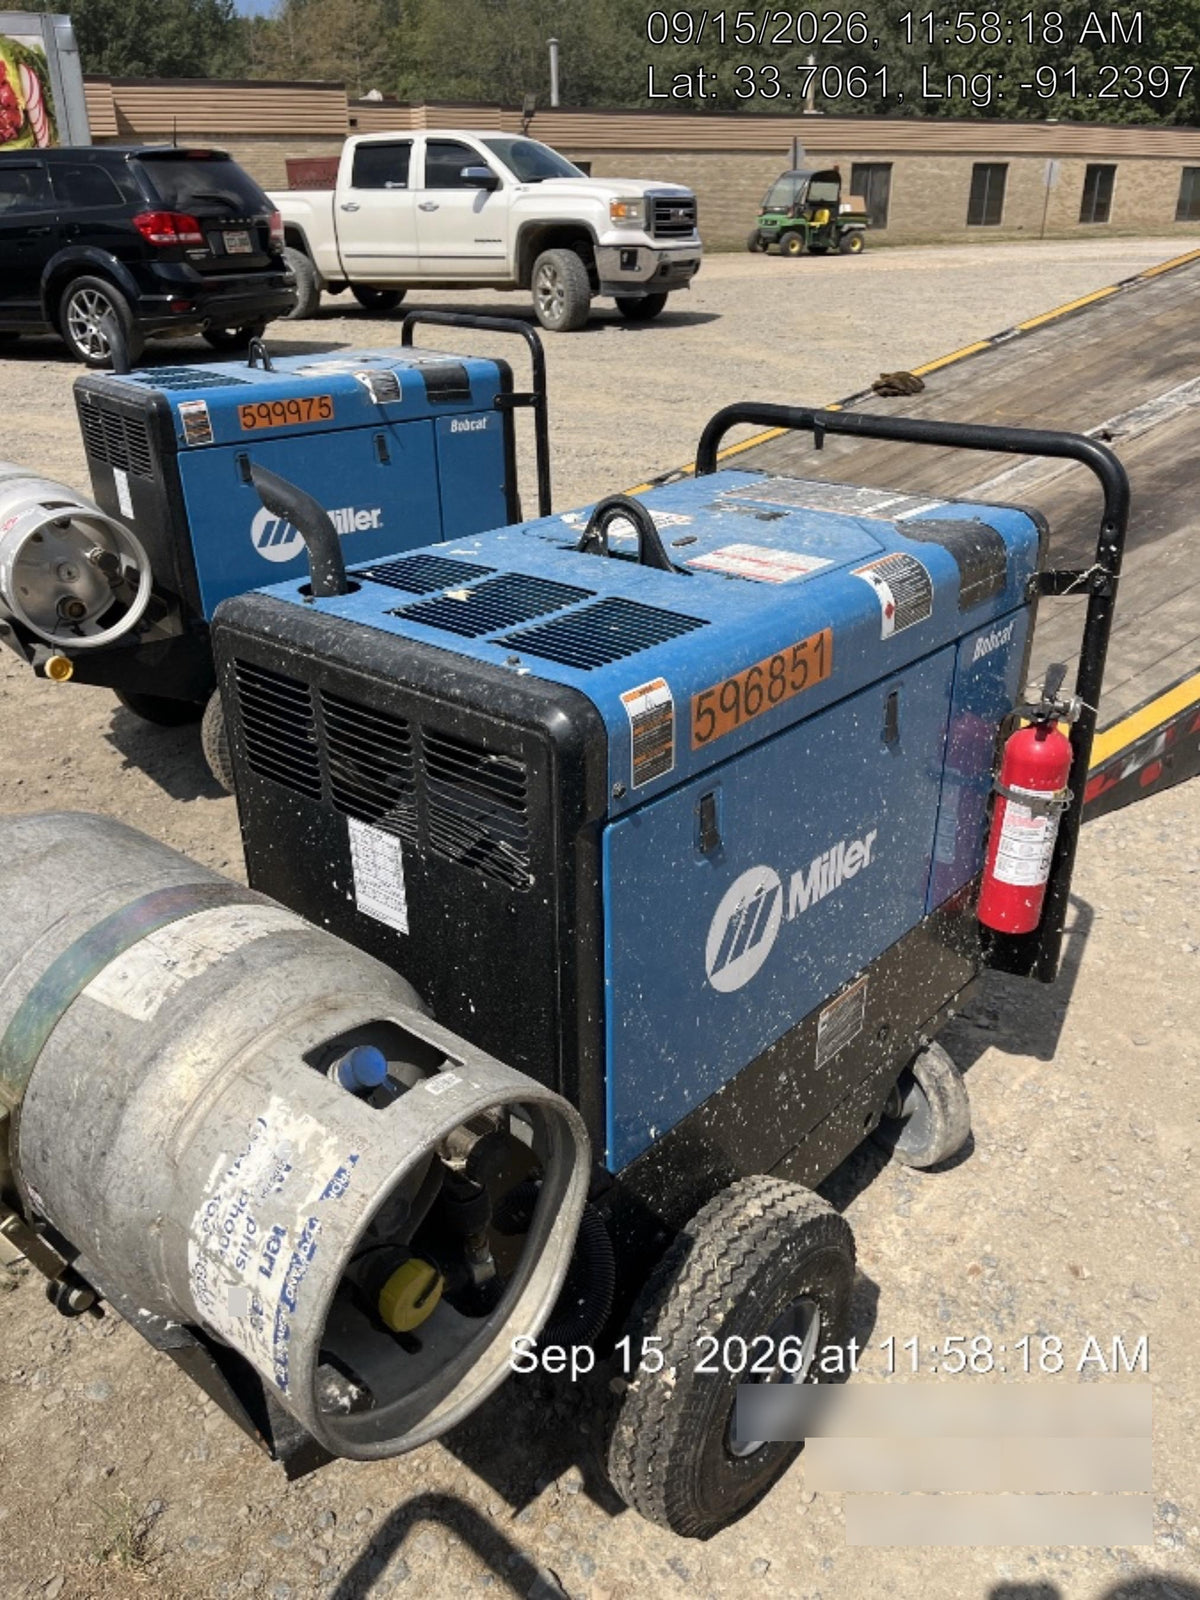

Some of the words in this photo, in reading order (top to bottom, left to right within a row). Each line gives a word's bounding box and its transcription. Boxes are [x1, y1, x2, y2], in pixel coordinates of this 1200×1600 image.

[242, 396, 331, 428] 599975
[450, 416, 488, 433] Bobcat
[972, 619, 1016, 662] Bobcat
[694, 632, 824, 742] 596851
[788, 828, 878, 922] Miller
